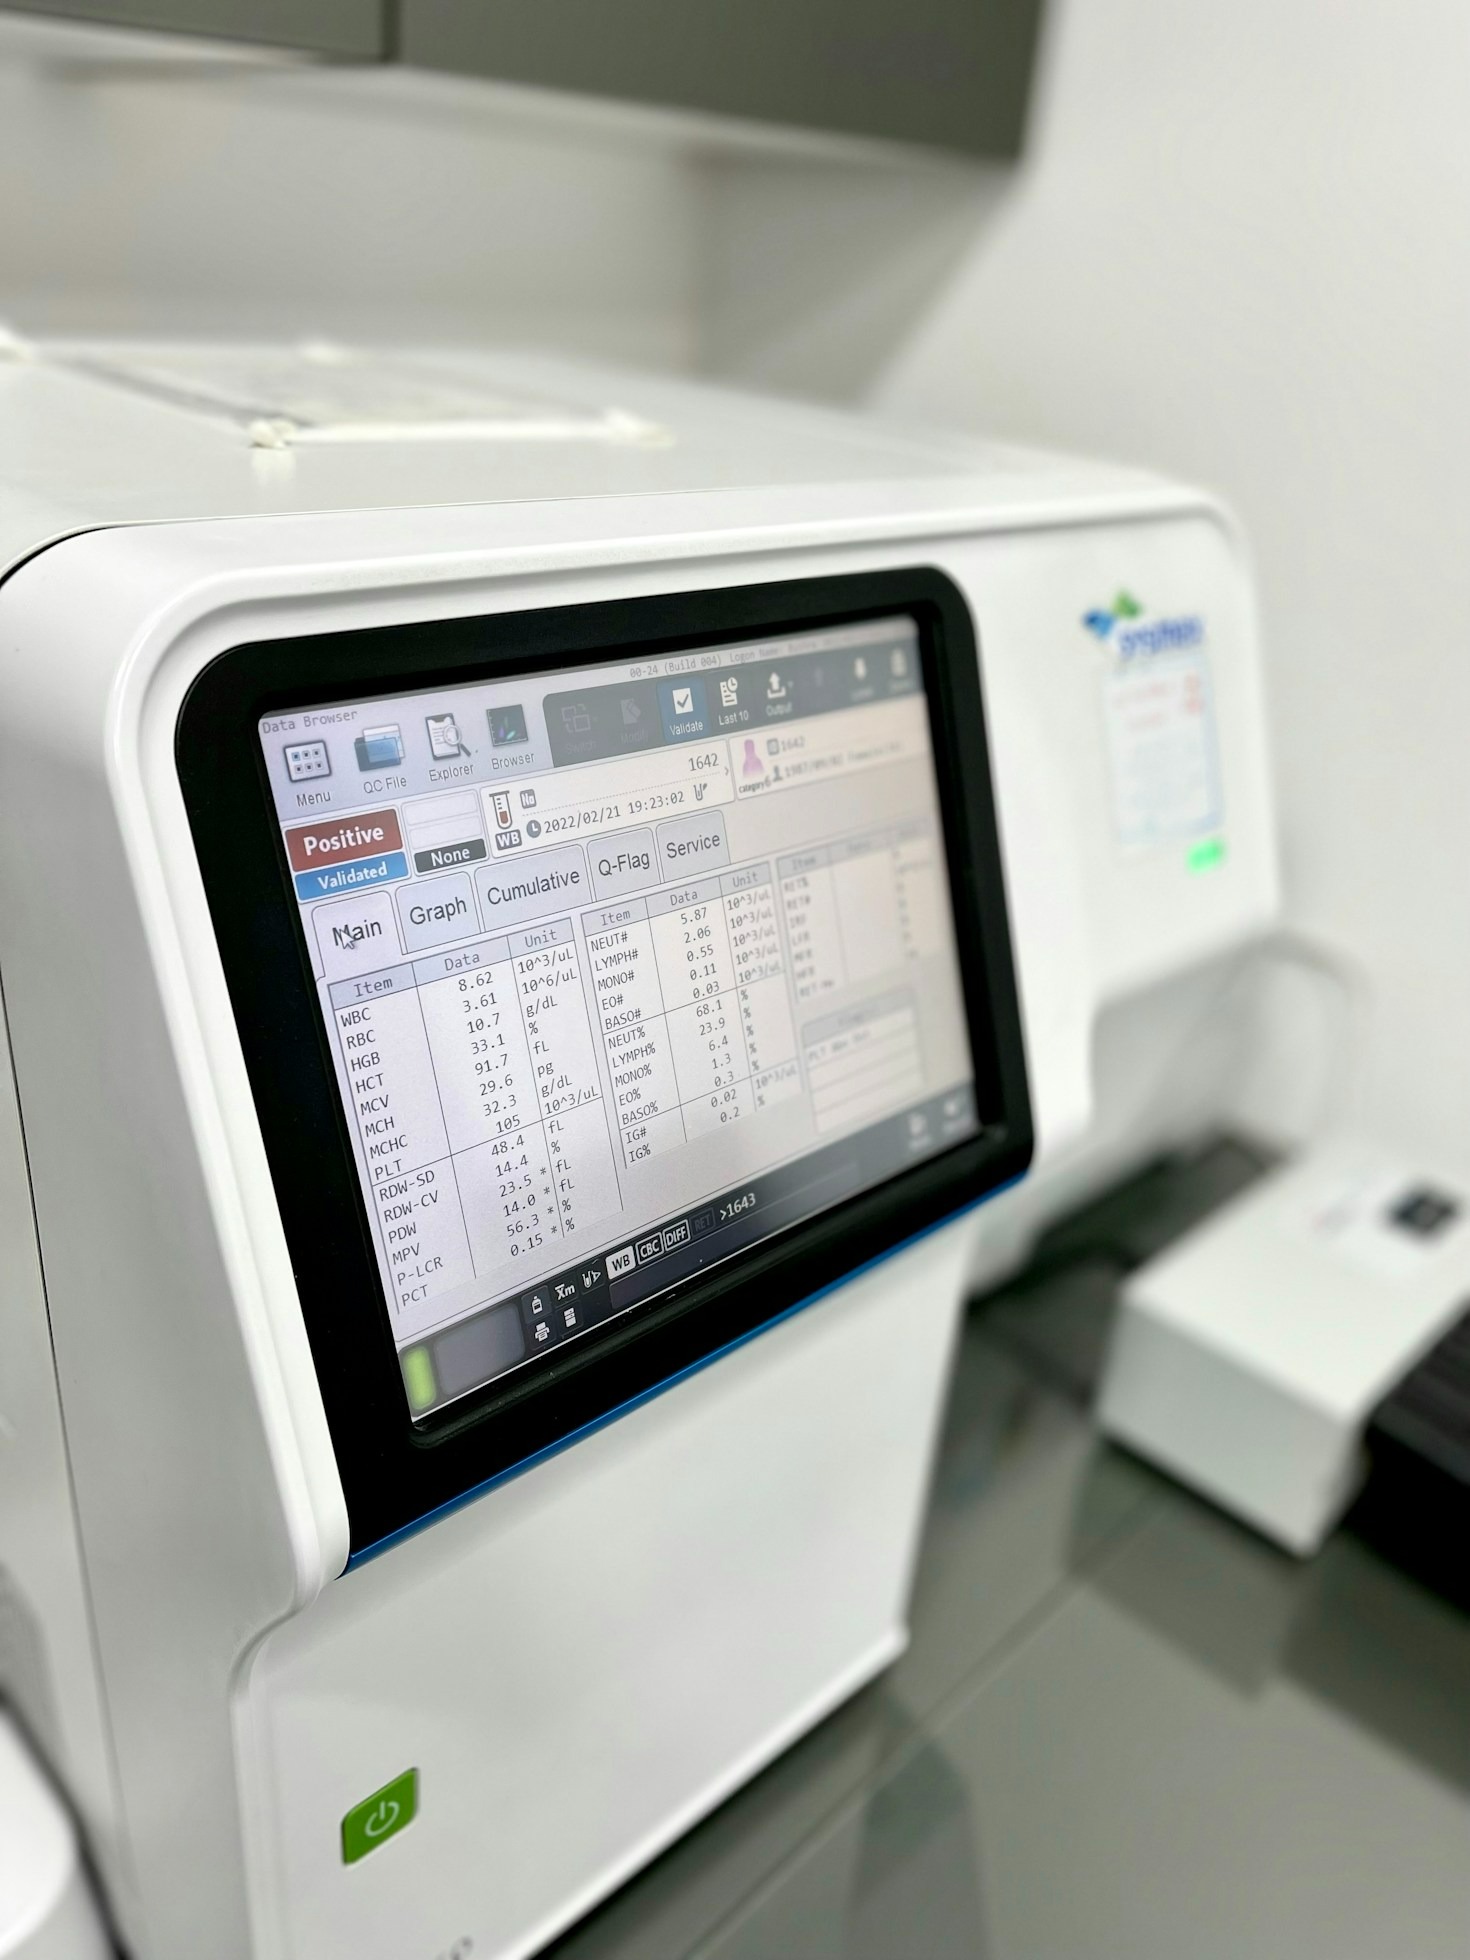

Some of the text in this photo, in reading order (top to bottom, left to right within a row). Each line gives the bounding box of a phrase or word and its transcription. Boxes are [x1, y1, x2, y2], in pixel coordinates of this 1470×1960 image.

[629, 664, 658, 678] 00-24
[664, 658, 697, 675] (Build
[700, 654, 722, 668] 004)
[729, 651, 756, 664] Logon
[262, 709, 358, 734] Data Browser
[669, 719, 704, 737] Validate
[718, 709, 749, 727] Last 10
[765, 701, 793, 718] Output
[429, 762, 474, 783] Explorer
[492, 751, 535, 771] Browser
[688, 752, 720, 772] 1642
[780, 736, 806, 753] 1642
[296, 790, 331, 808] Menu
[363, 775, 407, 795] QC File
[544, 790, 685, 834] 2022/02/21 19:23:02
[303, 824, 384, 857] Positive
[431, 847, 471, 867] None
[497, 831, 521, 848] WB
[598, 852, 650, 877] Q-Flag
[666, 832, 721, 859] Service
[317, 861, 388, 891] Validated
[487, 868, 581, 905] Cumulative
[600, 871, 759, 927] Item Data Unit
[331, 918, 383, 947] Main
[409, 896, 468, 926] Graph
[590, 889, 771, 952] NEUT# 5.87 10^3/uL
[594, 908, 773, 972] LYMPH# 2.06 10^3/uL
[340, 948, 574, 1027] WBC 8.62 10^3/uL
[354, 930, 557, 998] Item Data Unit
[597, 926, 776, 992] MONO# 0.55 10^3/uL
[601, 944, 779, 1011] EO# 0.11 10^3/uL
[346, 968, 577, 1050] RBC 3.61 10^6/uL
[605, 962, 781, 1030] BASO# 0.03 10^3/uL
[607, 988, 749, 1050] NEUT% 68.1 %
[350, 996, 558, 1072] HGB 10.7 g/dL
[355, 1021, 539, 1094] HCT 33.1 %
[611, 1007, 752, 1069] LYMPH% 23.9 %
[614, 1024, 754, 1087] MONO% 6.4 %
[359, 1040, 550, 1116] MCV 91.7 fL
[364, 1062, 554, 1137] MCH 29.6 pg
[618, 1042, 757, 1106] EO% 1.3 %
[621, 1060, 760, 1125] BASO% 0.3 %
[369, 1076, 573, 1159] MCHC 32.3 g/dL
[374, 1086, 599, 1180] PLT 105 10^3/uL
[625, 1065, 798, 1145] IG# 0.02 10^3/uL
[629, 1094, 766, 1164] IG% 0.2 %
[379, 1121, 564, 1202] RDW-SD 48.4 fL
[384, 1141, 561, 1223] RDW-CV 14.4 %
[387, 1222, 417, 1244] PDW
[499, 1175, 532, 1198] 23.5
[556, 1159, 572, 1173] fL
[392, 1243, 421, 1266] MPV
[503, 1194, 536, 1218] 14.0
[559, 1178, 575, 1192] fL
[695, 1214, 711, 1229] RET
[719, 1192, 756, 1221] >1643
[397, 1256, 444, 1287] P-LCR
[507, 1214, 540, 1238] 56.3
[562, 1198, 572, 1213] %
[401, 1284, 429, 1307] PCT
[510, 1234, 543, 1258] 0.15
[565, 1218, 575, 1232] %
[612, 1253, 631, 1272] WB
[640, 1238, 660, 1258] CBC
[665, 1226, 688, 1247] DIFF
